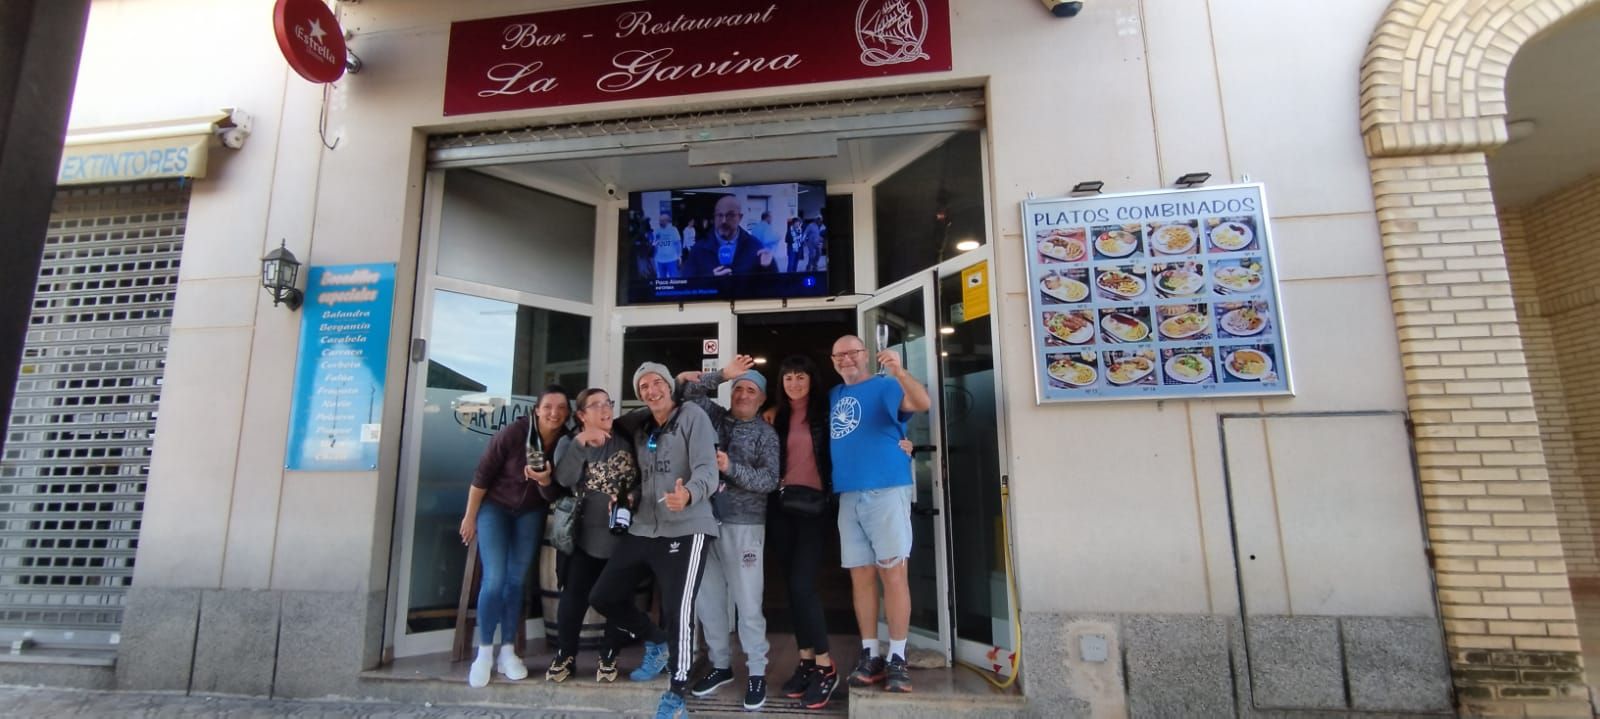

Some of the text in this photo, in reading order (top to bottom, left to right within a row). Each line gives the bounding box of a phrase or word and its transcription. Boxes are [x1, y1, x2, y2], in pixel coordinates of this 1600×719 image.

[501, 23, 567, 50] Bar
[615, 3, 779, 38] Restaurant
[294, 24, 336, 65] Estrella
[477, 47, 803, 98] La Gavina
[62, 146, 190, 180] EXTINTORES
[1033, 197, 1256, 227] PLATOS COMBINADOS
[321, 309, 371, 320] Balandra
[320, 334, 367, 345] Carabela
[489, 404, 508, 431] LA
